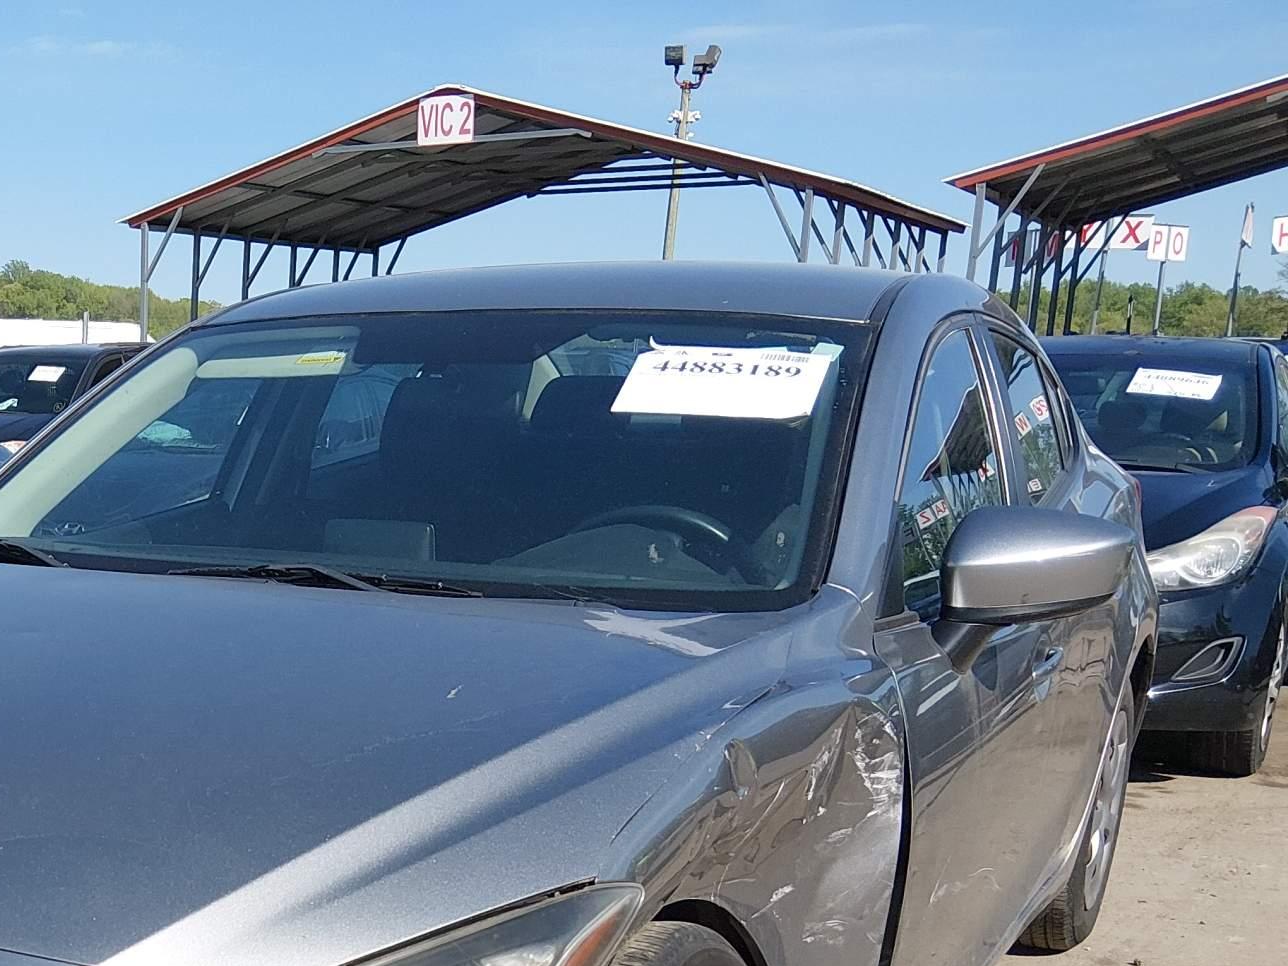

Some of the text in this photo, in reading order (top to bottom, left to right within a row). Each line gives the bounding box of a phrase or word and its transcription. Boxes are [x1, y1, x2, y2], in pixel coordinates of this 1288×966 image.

[420, 101, 472, 138] VIC 2
[1120, 221, 1144, 244] X
[1152, 231, 1163, 254] P
[652, 360, 802, 378] 44883189
